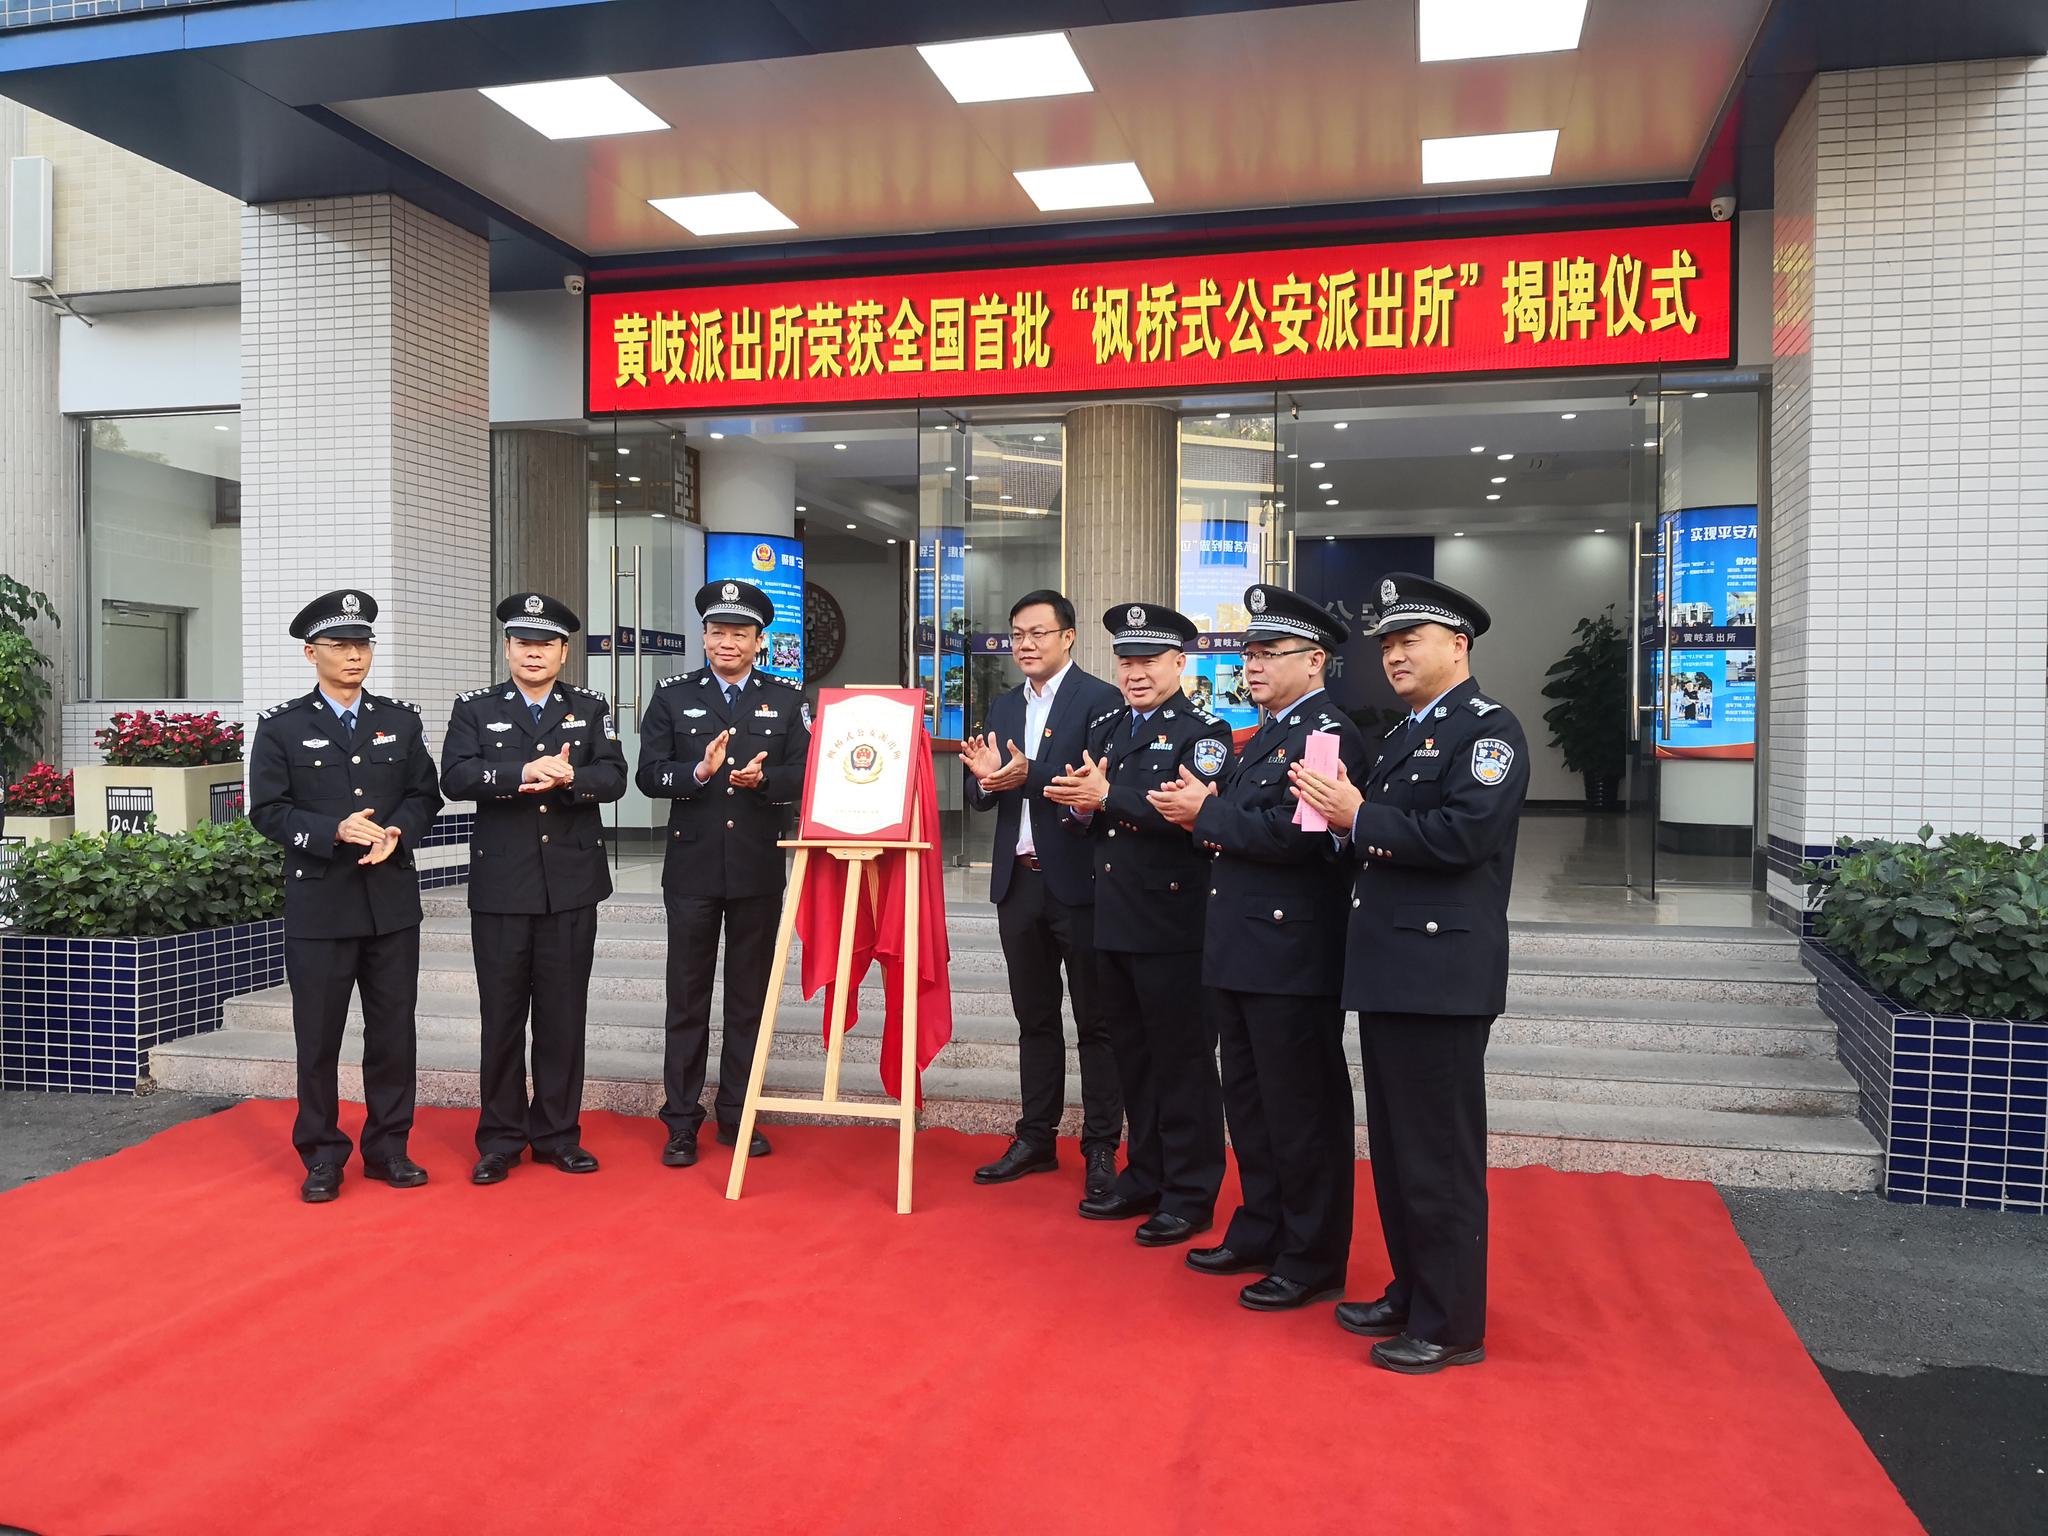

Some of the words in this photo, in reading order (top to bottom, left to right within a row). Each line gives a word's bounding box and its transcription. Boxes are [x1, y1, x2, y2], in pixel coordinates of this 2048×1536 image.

[1683, 633, 1737, 643] 黄岐派出所
